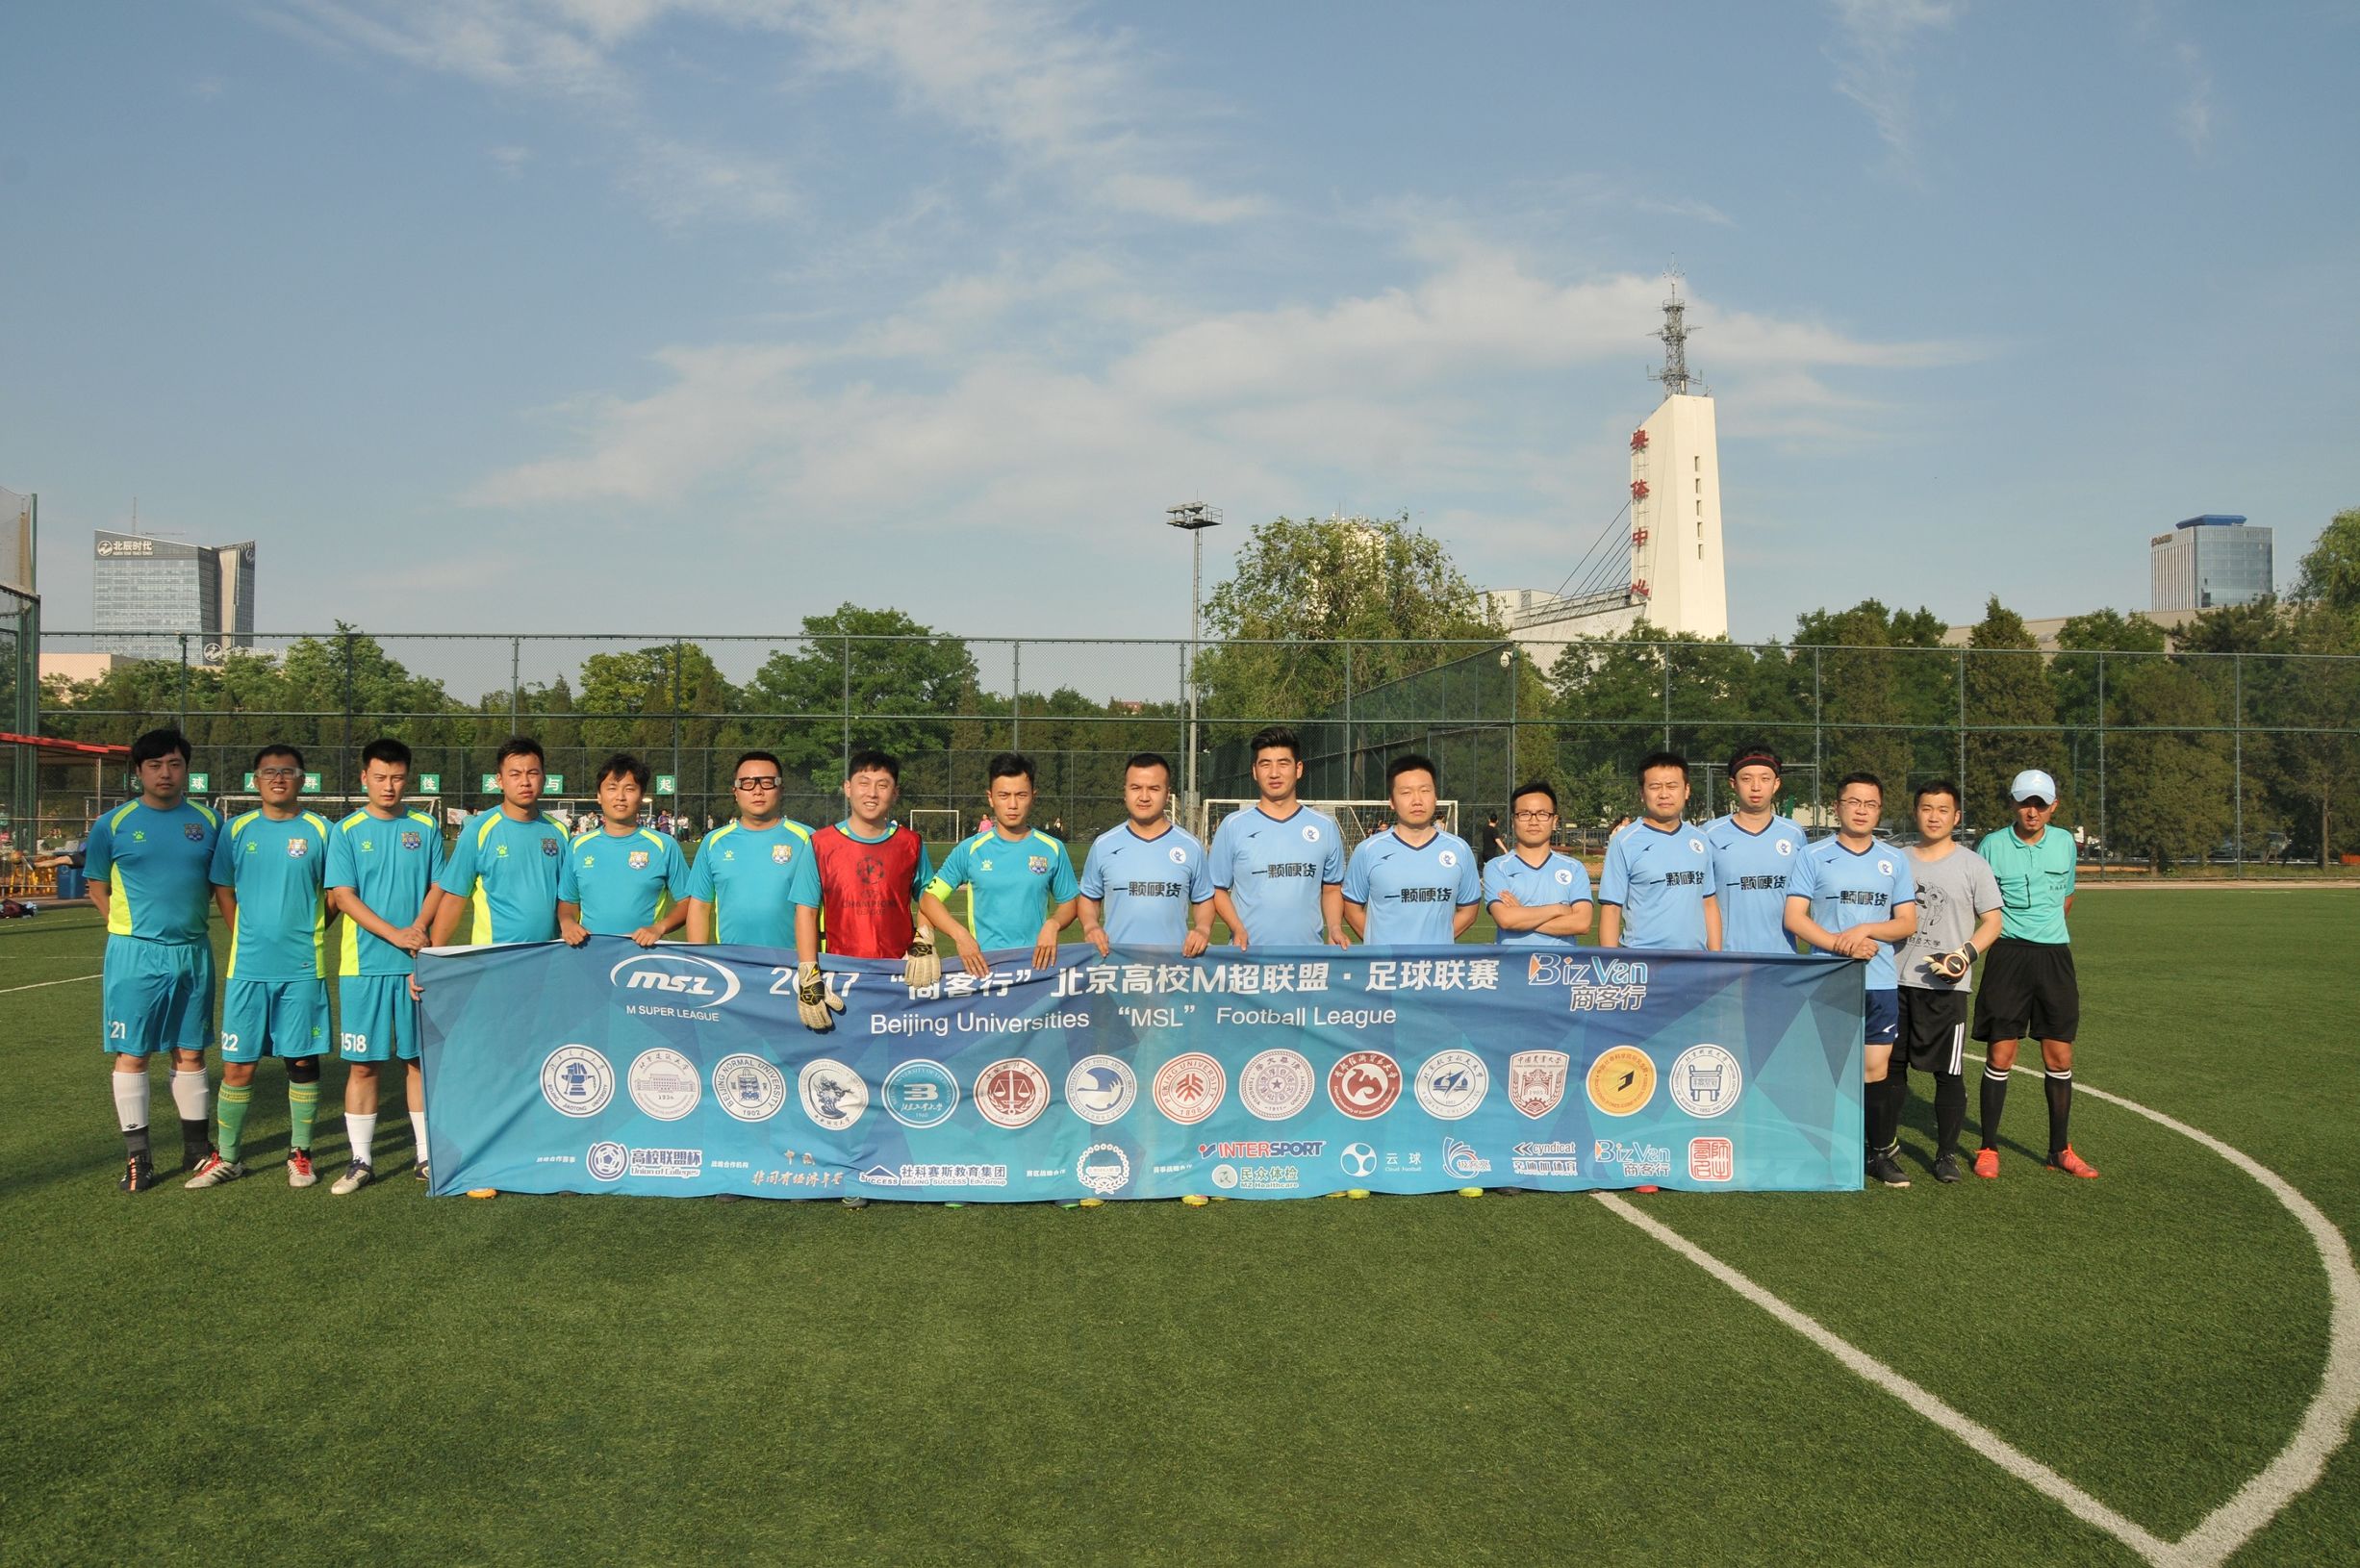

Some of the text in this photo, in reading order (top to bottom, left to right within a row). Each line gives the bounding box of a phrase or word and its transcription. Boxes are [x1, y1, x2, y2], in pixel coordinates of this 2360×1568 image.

[1630, 429, 1650, 596] 奥体中心
[114, 541, 153, 551] 北辰时代
[770, 967, 860, 998] 217
[1570, 985, 1646, 1011] 商客行
[626, 1005, 720, 1022] M SUPER LEAGUE
[871, 1013, 949, 1036] Beijing
[956, 1011, 1090, 1033] Universities
[1217, 1007, 1306, 1025] Football
[1314, 1006, 1396, 1029] League
[723, 1058, 754, 1074] NORMAL
[718, 1074, 734, 1107] BEIJING
[757, 1063, 782, 1109] UNIVERSITY
[1162, 1068, 1178, 1104] PEKING
[1180, 1061, 1217, 1099] UNIVERSITY
[1219, 1142, 1324, 1157] INTERSPORT
[631, 1150, 701, 1166] 高校联盟杯
[631, 1167, 699, 1177] Union of Colleges
[901, 1165, 1006, 1178] 社科赛斯教育集团
[1241, 1167, 1298, 1181] 民众体检
[1624, 1162, 1671, 1177] 商客行
